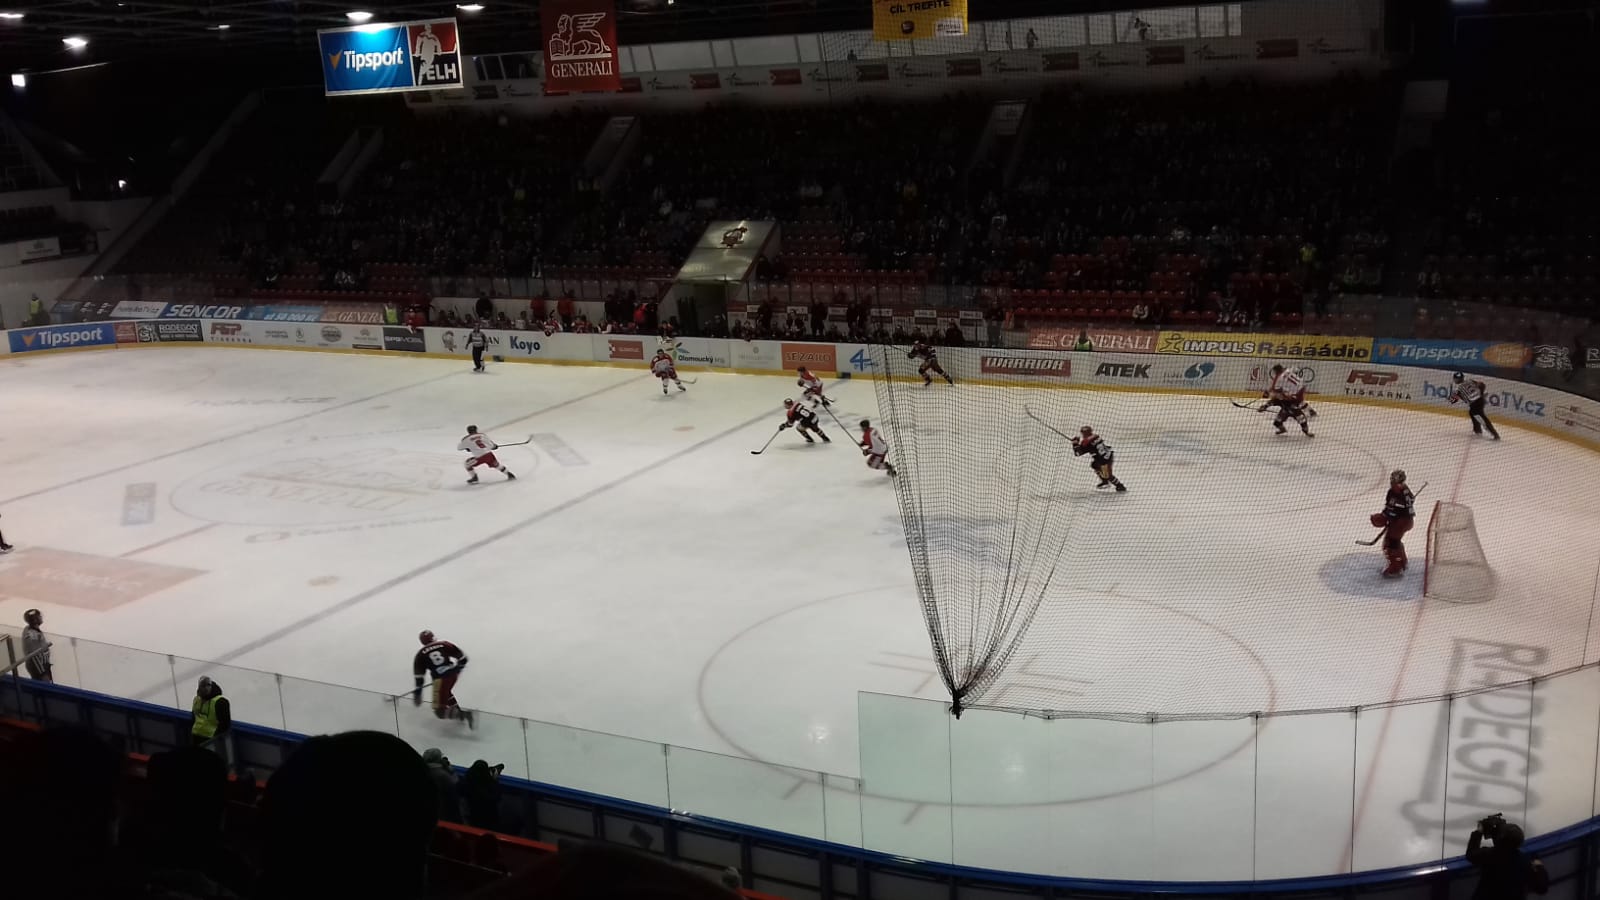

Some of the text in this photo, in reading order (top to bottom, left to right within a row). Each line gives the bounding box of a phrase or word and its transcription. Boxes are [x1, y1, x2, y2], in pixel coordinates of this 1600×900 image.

[343, 47, 404, 72] Tipsport
[425, 63, 457, 81] ELH
[551, 60, 614, 79] GENERALI
[166, 304, 240, 318] SENCOR
[38, 328, 104, 346] Tipsport
[509, 336, 541, 354] Koyo
[1060, 335, 1153, 351] GNERALI
[1183, 341, 1255, 354] IMPULS
[1400, 344, 1479, 361] Tipsport
[985, 357, 1064, 370] WARRIOR
[1095, 363, 1151, 378] ATEK
[429, 650, 445, 666] 8
